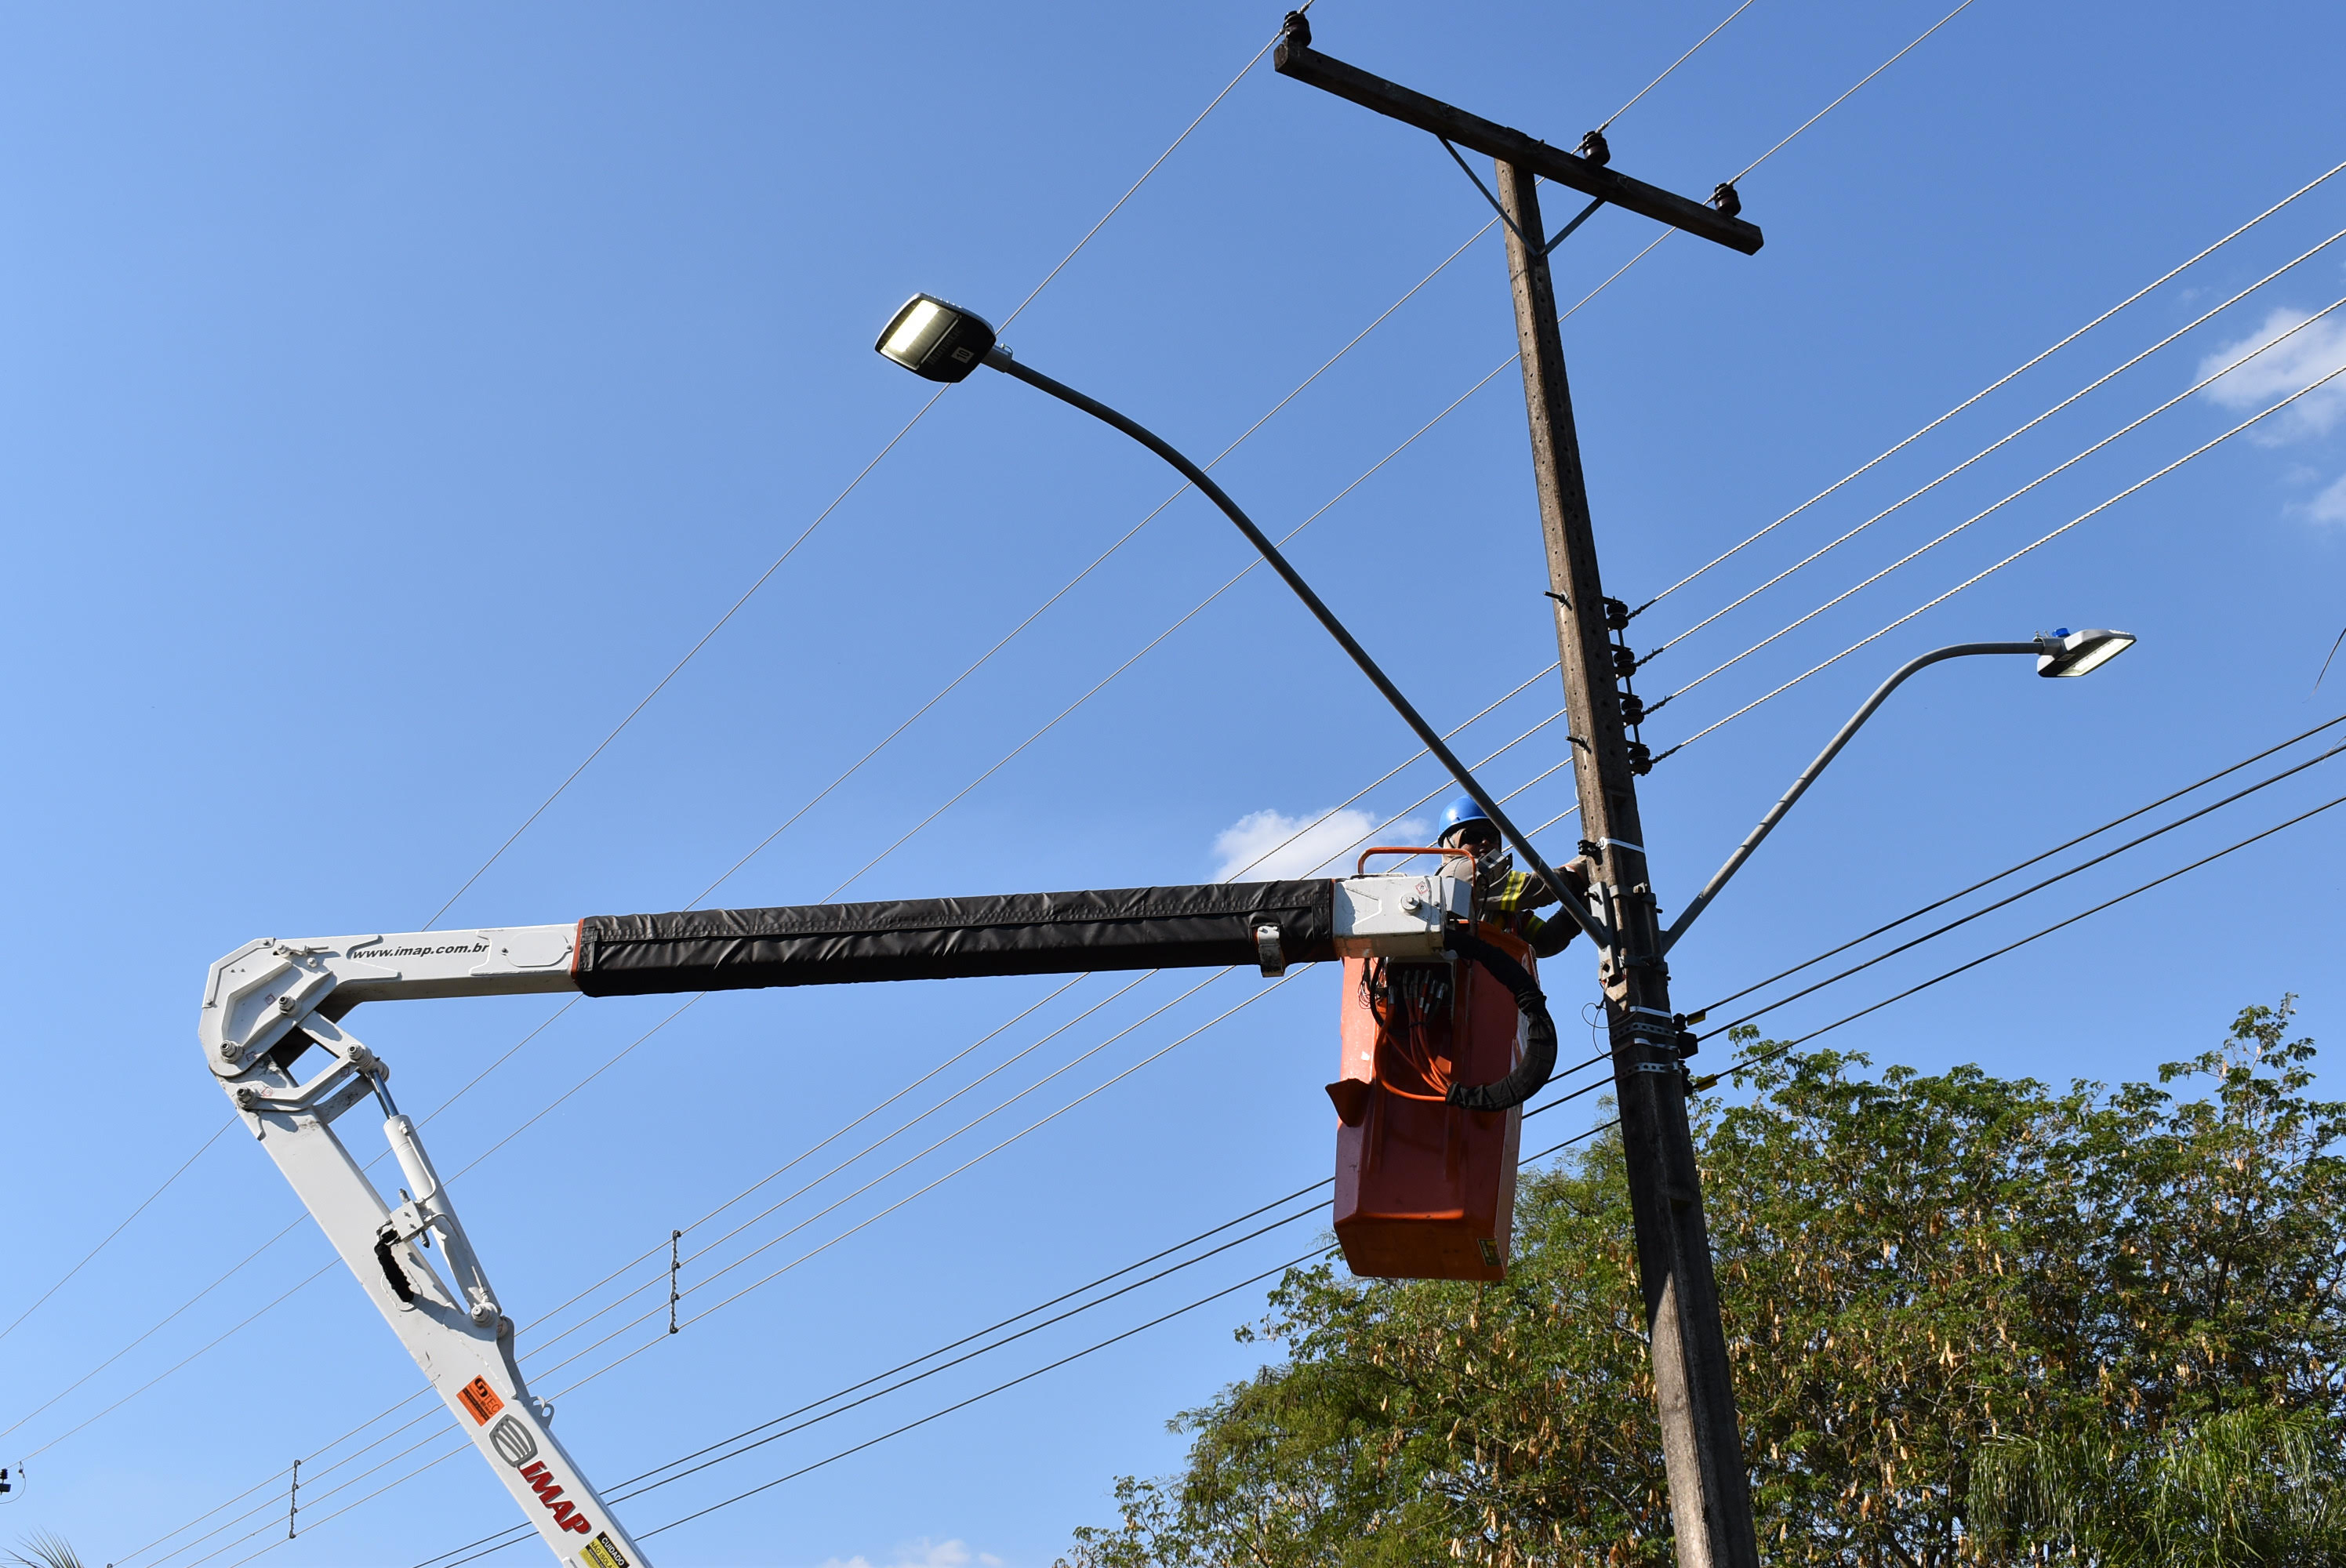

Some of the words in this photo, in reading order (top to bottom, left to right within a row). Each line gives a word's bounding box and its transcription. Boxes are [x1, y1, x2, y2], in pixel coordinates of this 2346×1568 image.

[957, 350, 970, 359] 10
[353, 942, 490, 959] www.imap.com.br
[517, 1461, 592, 1535] IMAP
[601, 1537, 625, 1566] CUIDADO
[598, 1553, 615, 1568] ISOLA
